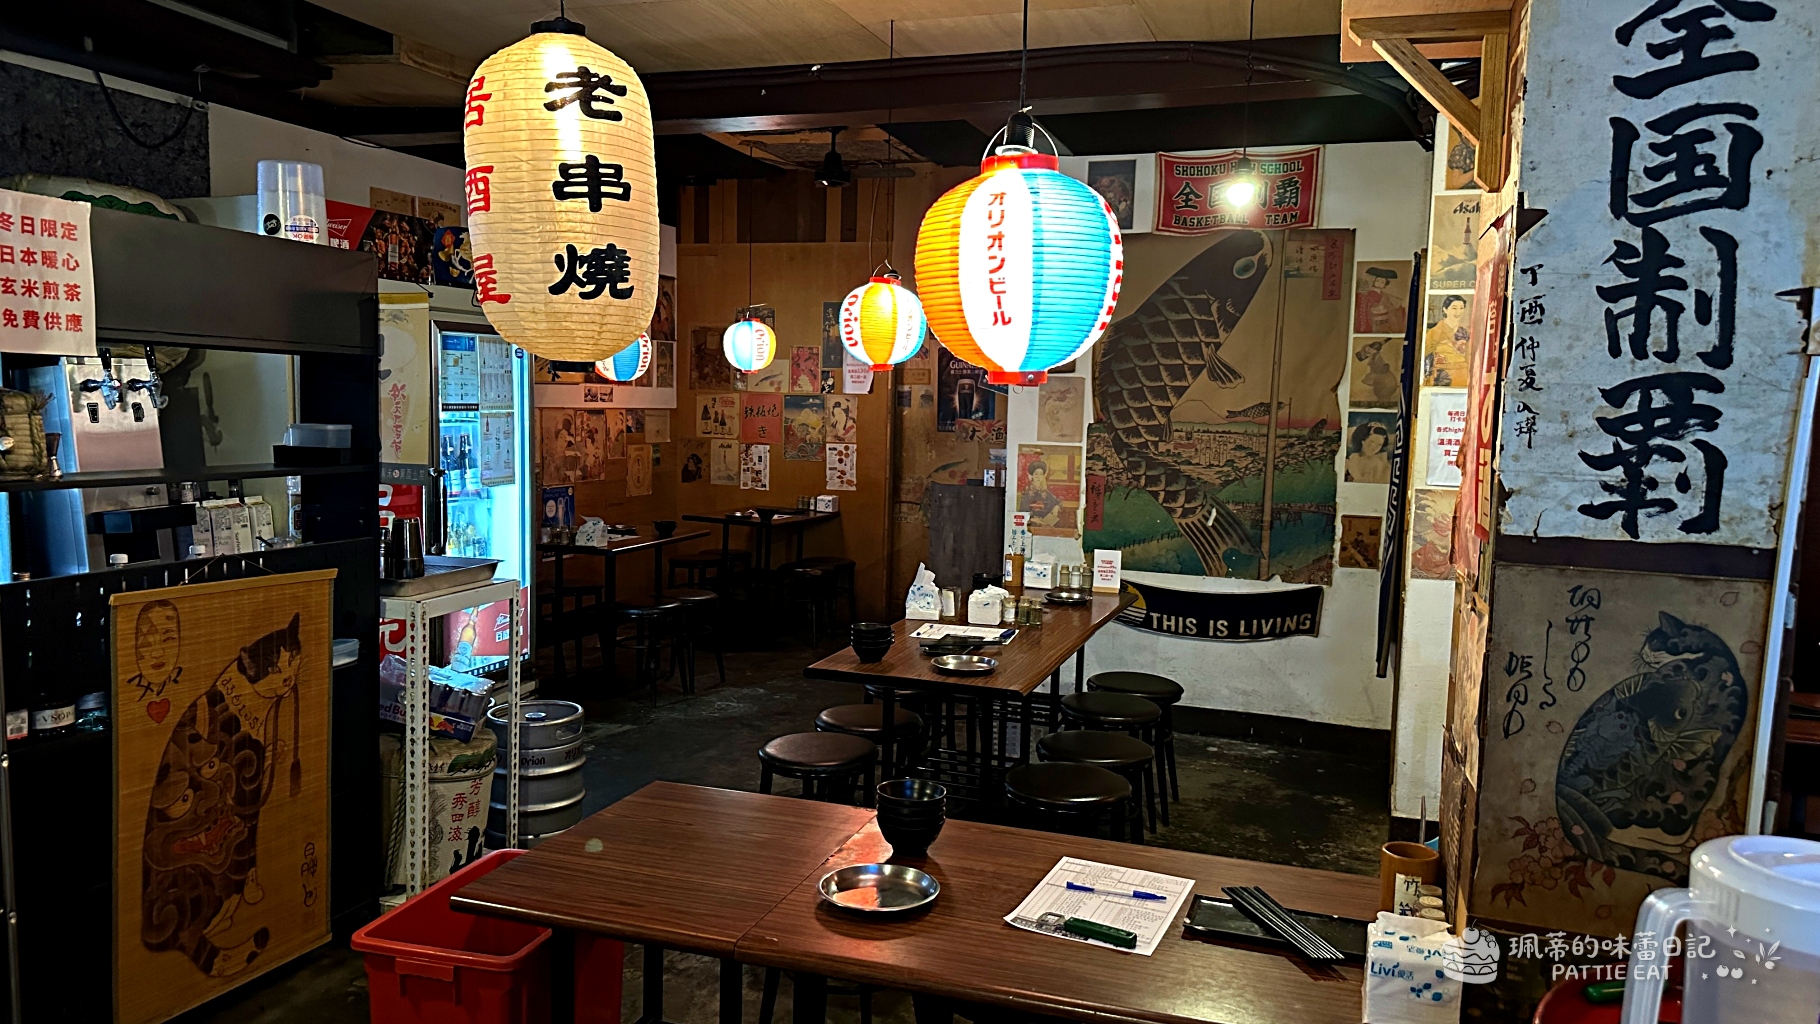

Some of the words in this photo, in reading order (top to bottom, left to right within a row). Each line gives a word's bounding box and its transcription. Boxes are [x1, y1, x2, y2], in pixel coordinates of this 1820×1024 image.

[1174, 163, 1227, 177] SHOHOKU
[1260, 160, 1304, 175] SCHOOL
[543, 66, 635, 300] 老串燒
[0, 211, 78, 242] 冬日限定
[1173, 213, 1248, 227] BASKETBALL
[1265, 212, 1299, 225] TEAM
[0, 244, 80, 272] 日本暖心
[986, 191, 1012, 327] オリオンビール
[0, 276, 82, 302] 玄米煎茶
[1432, 280, 1466, 289] SUPER
[2, 308, 83, 333] 免費供應
[843, 294, 860, 348] Orion
[1149, 612, 1198, 635] THIS
[1208, 619, 1229, 637] IS
[1239, 613, 1312, 637] LIVING
[521, 755, 546, 766] Orion
[1370, 961, 1399, 978] Livi
